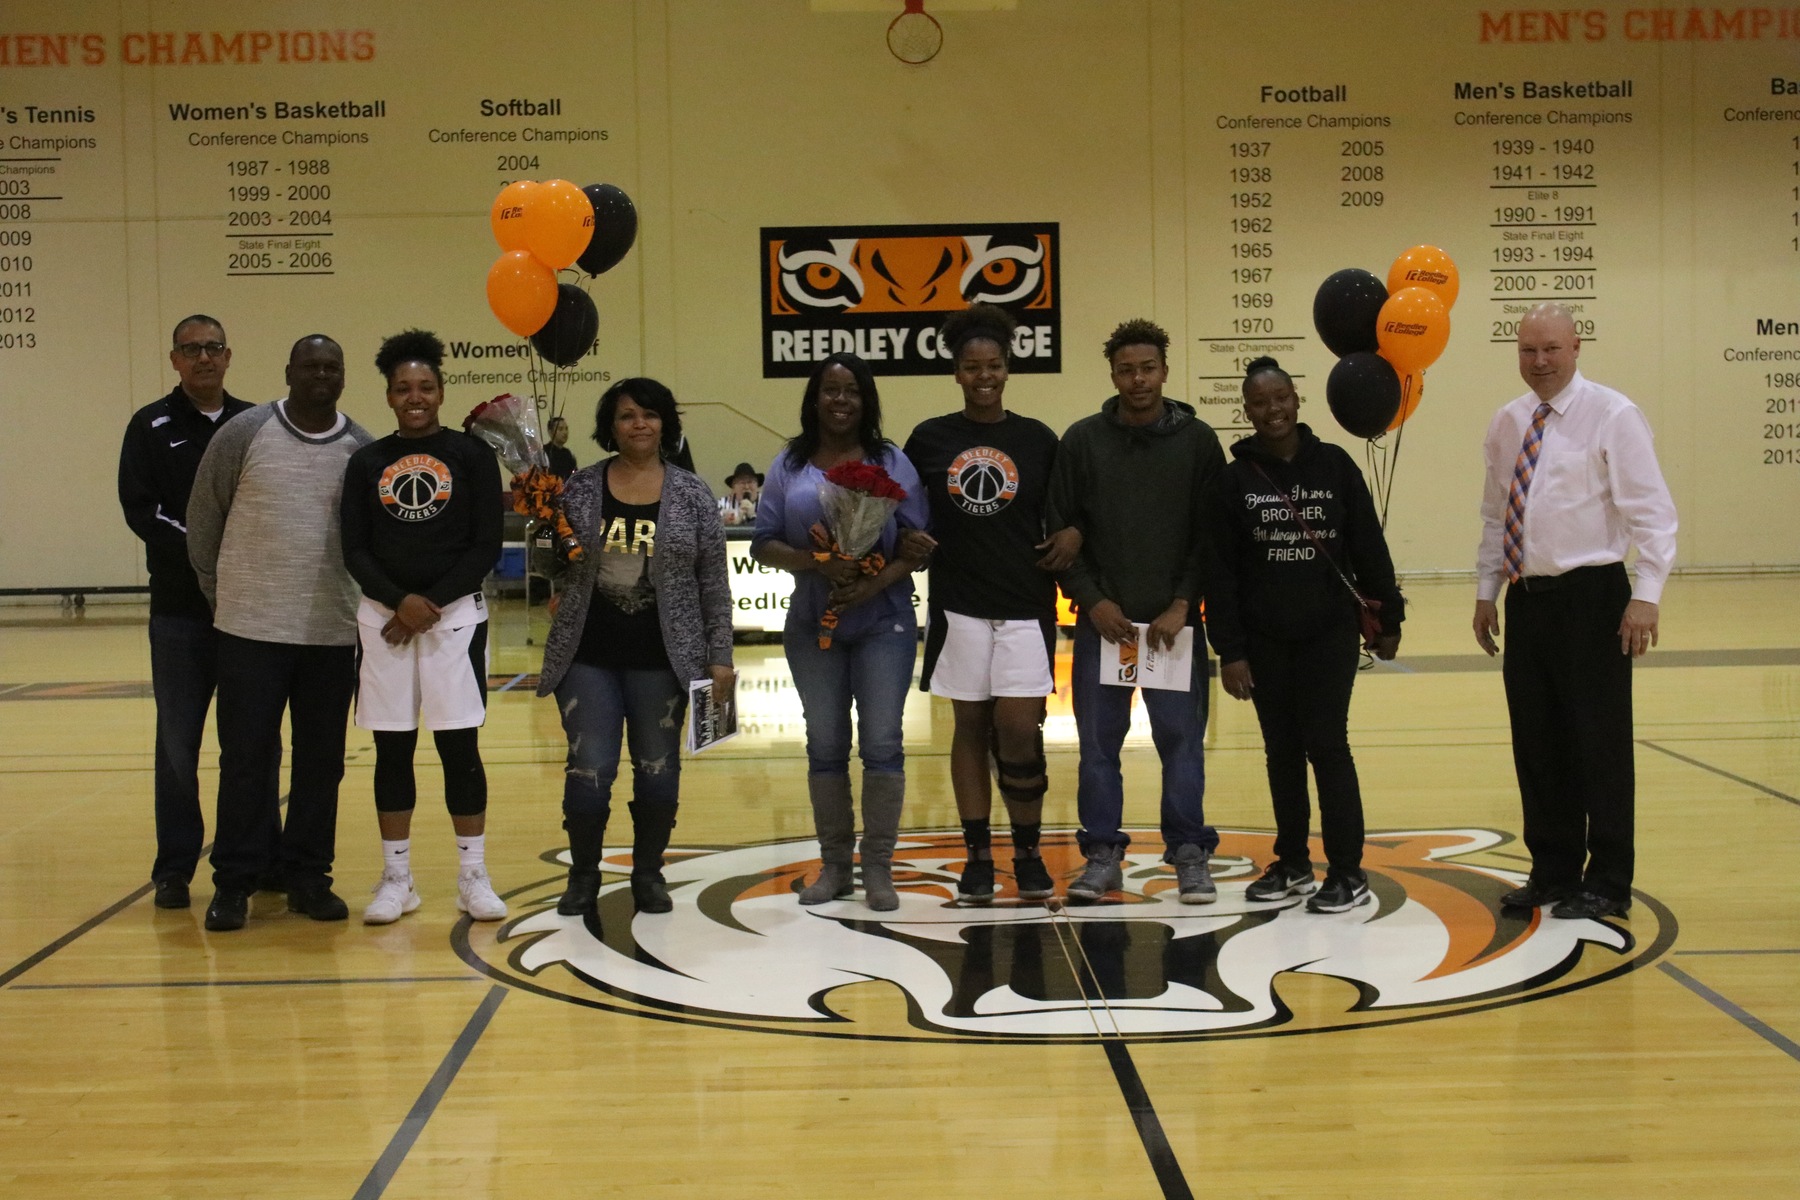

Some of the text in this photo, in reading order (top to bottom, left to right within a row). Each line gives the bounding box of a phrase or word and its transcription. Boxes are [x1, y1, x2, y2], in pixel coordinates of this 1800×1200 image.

[1480, 9, 1607, 43] MEN'S
[121, 30, 376, 66] CHAMPIONS
[1260, 85, 1347, 104] Football
[1454, 80, 1633, 100] Men's Basketball
[25, 105, 96, 124] Tennis
[168, 101, 386, 122] Women's Basketball
[480, 99, 561, 117] Softball
[1216, 114, 1392, 131] Conference Champions
[1453, 110, 1633, 127] Conference Champions
[9, 134, 97, 151] Champions
[188, 131, 370, 147] Conference Champions
[428, 128, 609, 145] Conference Champions
[1230, 142, 1272, 158] 1937
[1341, 141, 1385, 157] 2005
[1492, 140, 1535, 156] 1939
[1553, 139, 1595, 155] 1940
[227, 161, 269, 177] 1987
[288, 160, 330, 176] 1988
[497, 155, 540, 171] 2004
[1230, 167, 1272, 184] 1938
[1341, 166, 1384, 182] 2008
[1493, 165, 1532, 181] 1941
[1553, 164, 1595, 180] 1942
[228, 186, 271, 202] 1999
[287, 185, 331, 201] 2000
[1230, 192, 1272, 209] 1952
[1340, 191, 1385, 207] 2009
[228, 211, 272, 227] 2003
[289, 210, 332, 227] 2004
[1494, 207, 1536, 223] 1990
[1554, 206, 1593, 222] 1991
[1231, 218, 1273, 234] 1962
[1231, 243, 1273, 259] 1965
[1493, 247, 1535, 263] 1993
[1553, 246, 1594, 262] 1994
[228, 253, 272, 270] 2005
[289, 252, 333, 269] 2006
[1231, 268, 1273, 284] 1967
[1493, 276, 1537, 292] 2000
[1553, 275, 1594, 291] 2001
[0, 281, 32, 297] 011
[1232, 293, 1274, 309] 1969
[0, 307, 36, 324] 012
[1232, 318, 1274, 334] 1970
[1493, 321, 1521, 337] 200
[772, 327, 910, 362] REEDLEY
[527, 369, 611, 385] Champions
[1766, 398, 1800, 414] 201
[392, 457, 440, 472] REEDLEY
[961, 449, 1009, 463] REEDLEY
[1326, 490, 1334, 499] a
[397, 504, 437, 519] TIGERS
[962, 500, 999, 514] TIGERS
[1267, 547, 1316, 561] FRIEND
